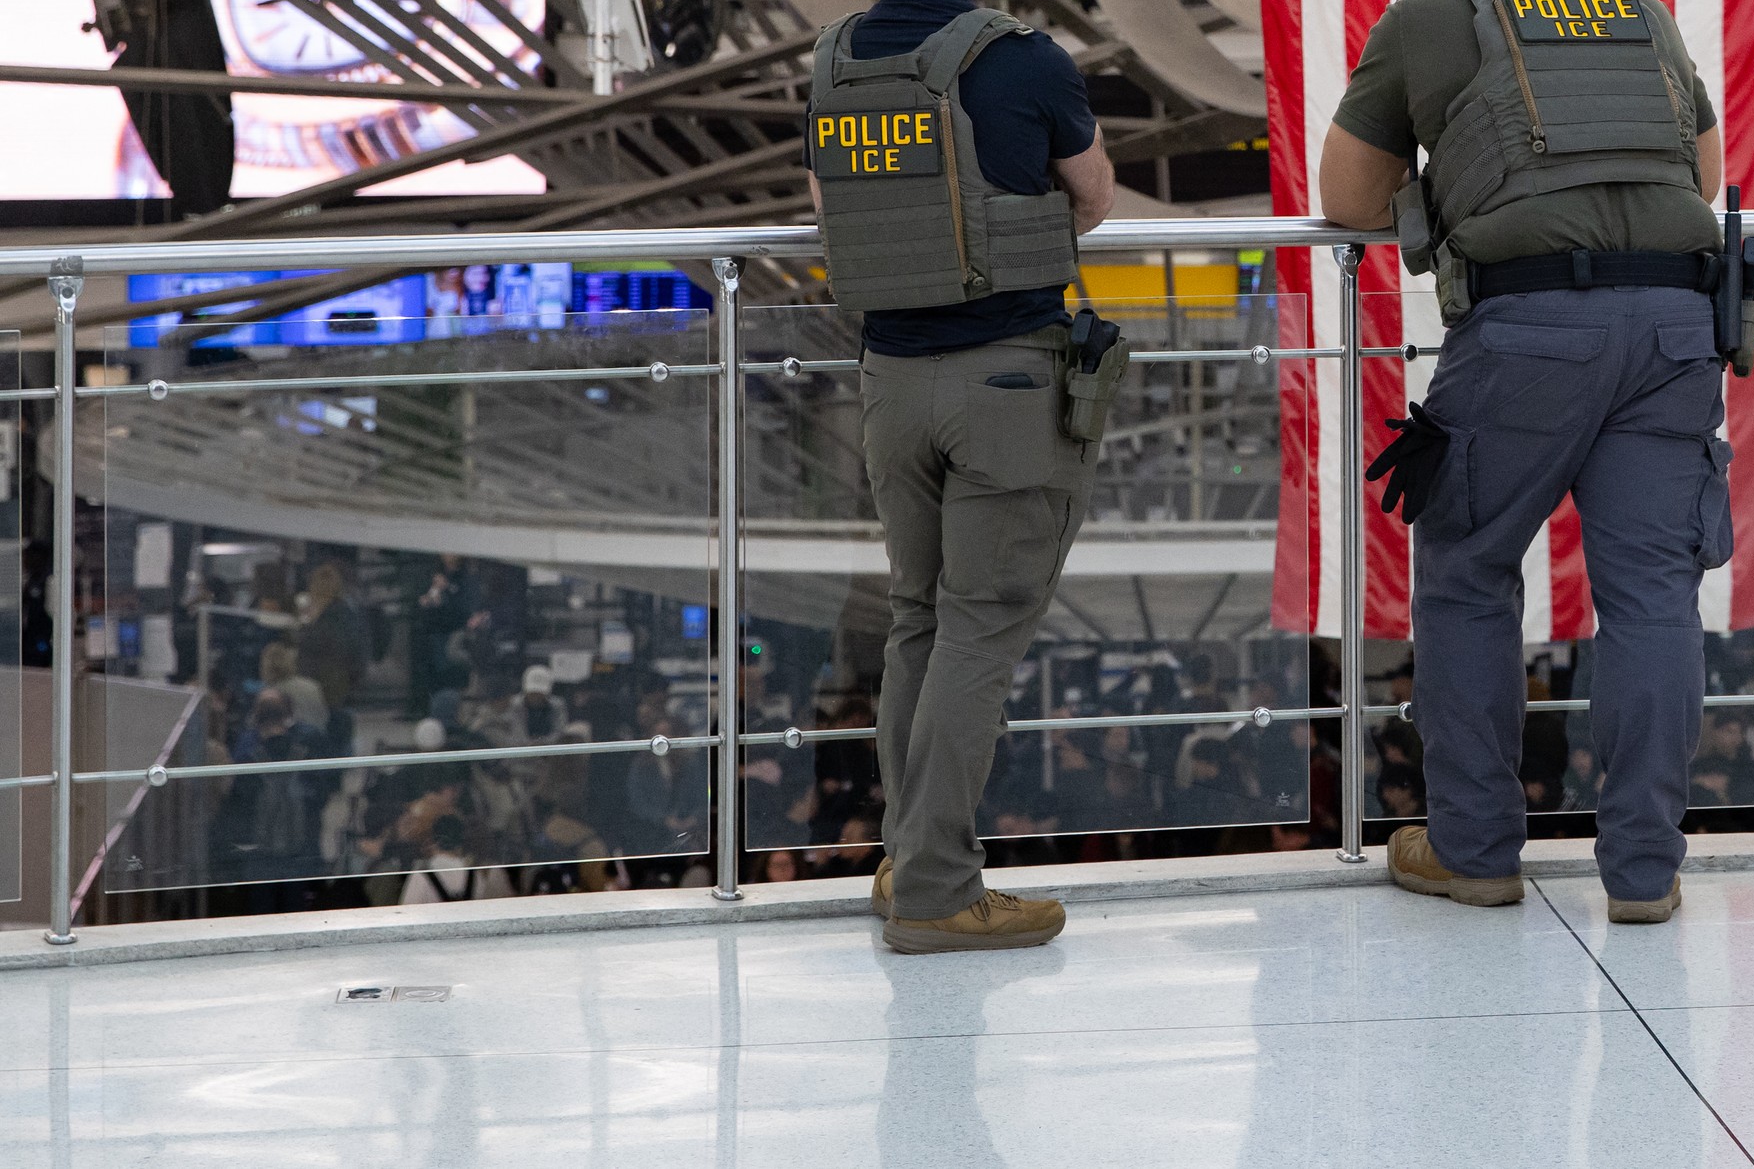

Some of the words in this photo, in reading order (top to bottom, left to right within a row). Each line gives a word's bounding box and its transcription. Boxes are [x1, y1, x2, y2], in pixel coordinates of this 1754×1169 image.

[1554, 21, 1612, 37] ICE
[817, 112, 933, 148] POLICE
[851, 148, 901, 173] ICE
